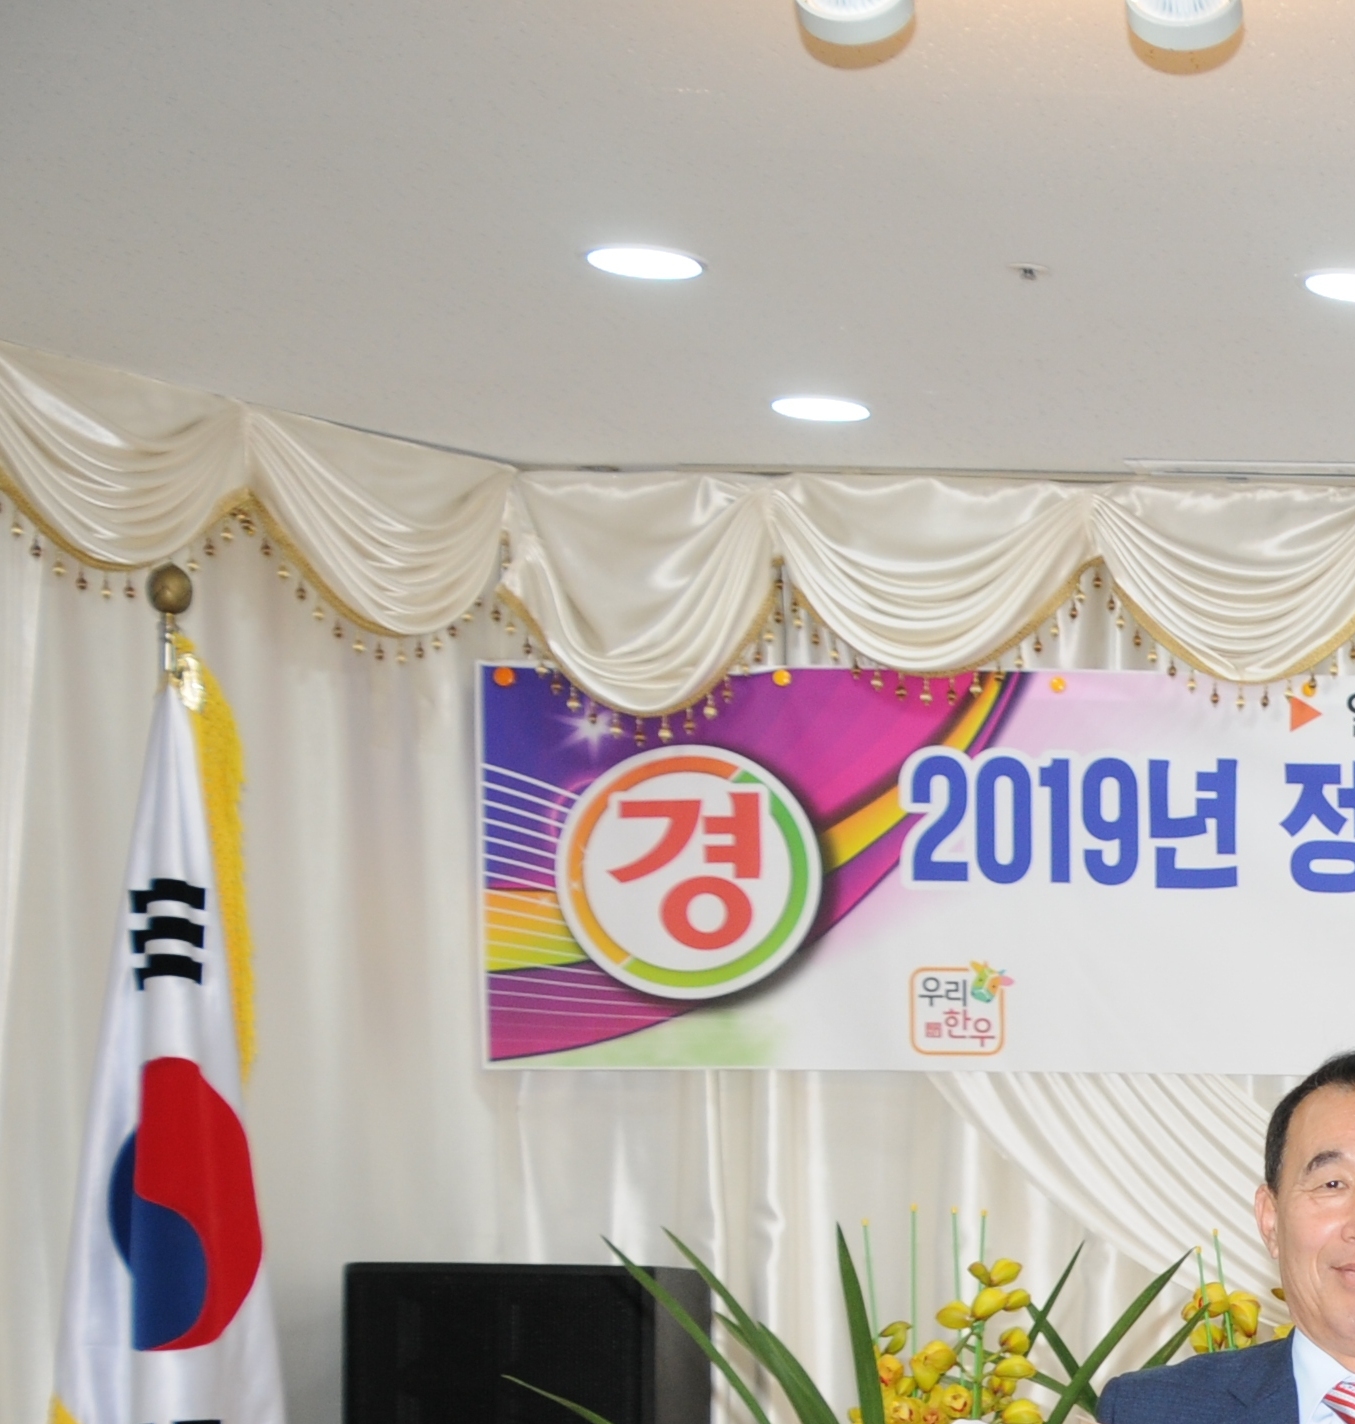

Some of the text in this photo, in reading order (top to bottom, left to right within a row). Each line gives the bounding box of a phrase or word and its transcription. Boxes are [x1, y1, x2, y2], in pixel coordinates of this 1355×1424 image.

[911, 755, 1239, 889] 2019년
[607, 791, 763, 951] 경
[917, 977, 967, 1008] 우리
[942, 1008, 996, 1048] 한우
